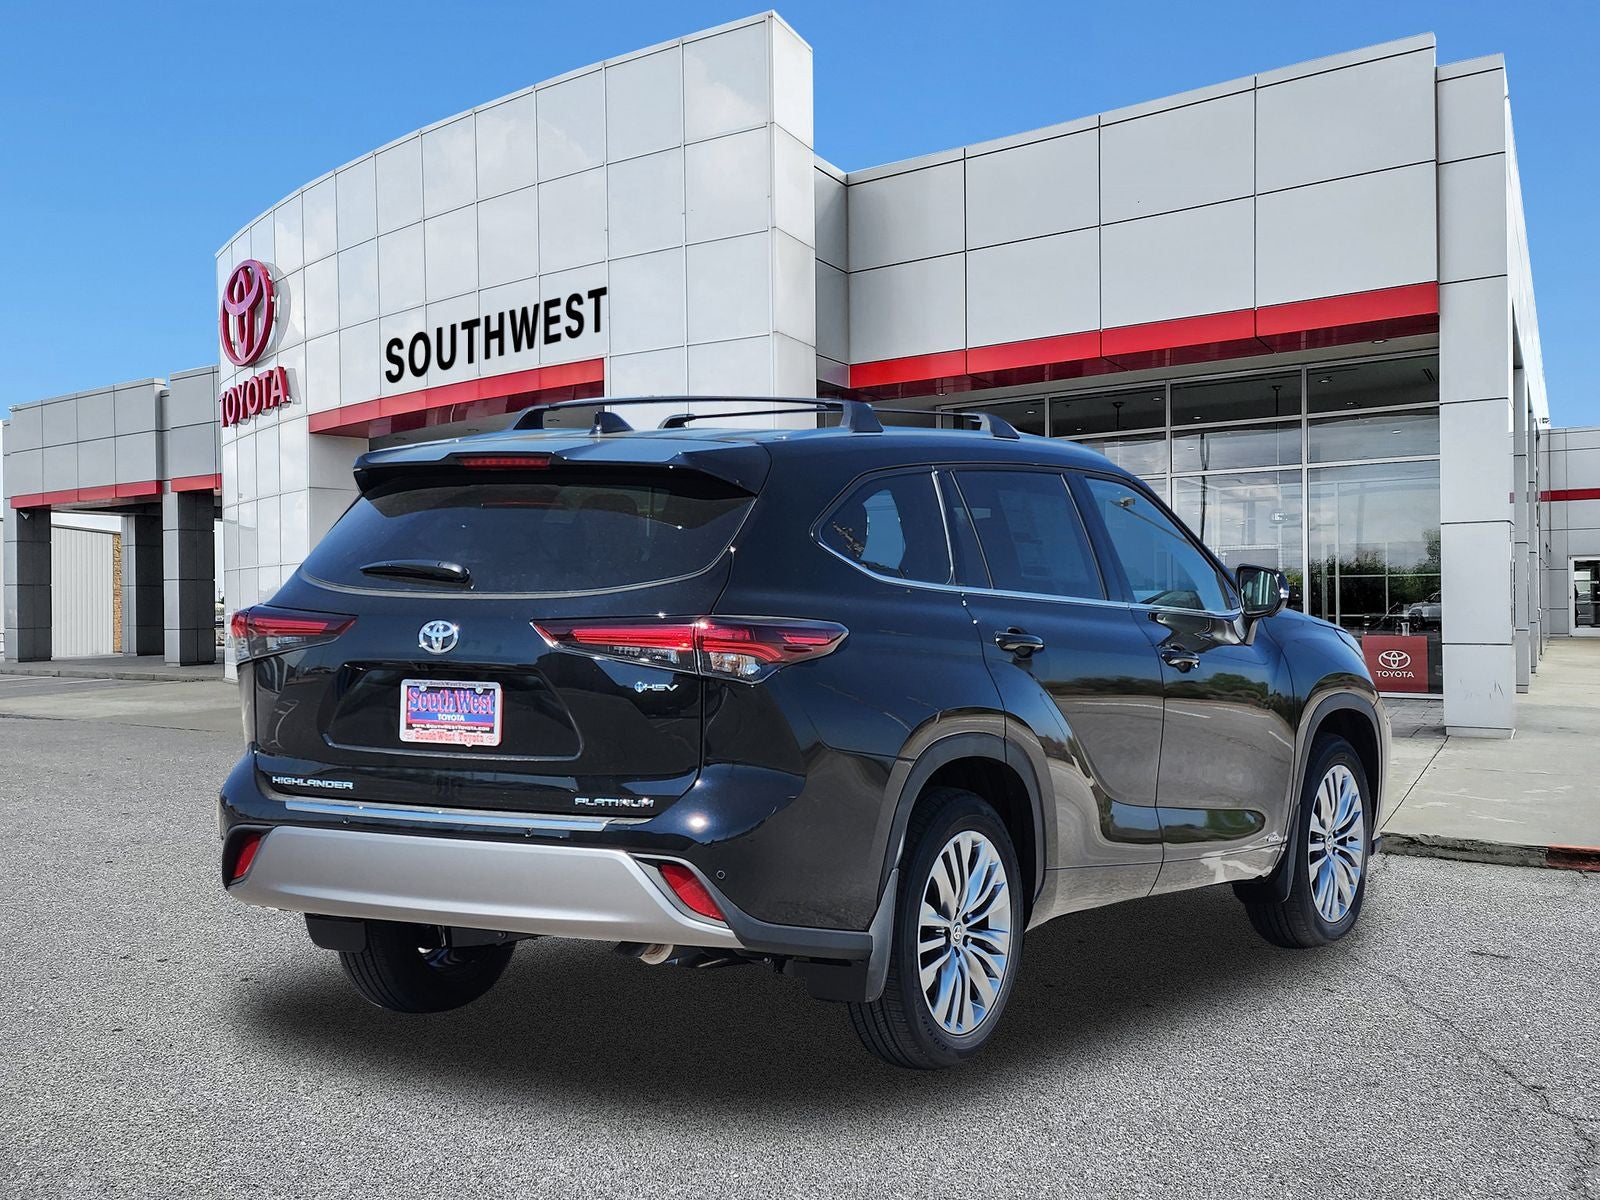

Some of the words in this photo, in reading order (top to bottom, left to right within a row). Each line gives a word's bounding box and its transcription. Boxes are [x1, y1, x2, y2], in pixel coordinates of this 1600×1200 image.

[384, 286, 608, 384] SOUTHWEST
[219, 366, 290, 428] TOYOTA
[1376, 670, 1415, 678] TOYOTA
[408, 687, 496, 715] SouthWest
[437, 713, 466, 722] TOYOTA
[272, 776, 354, 790] HIGHLANDER
[574, 797, 655, 808] PLATINUM
